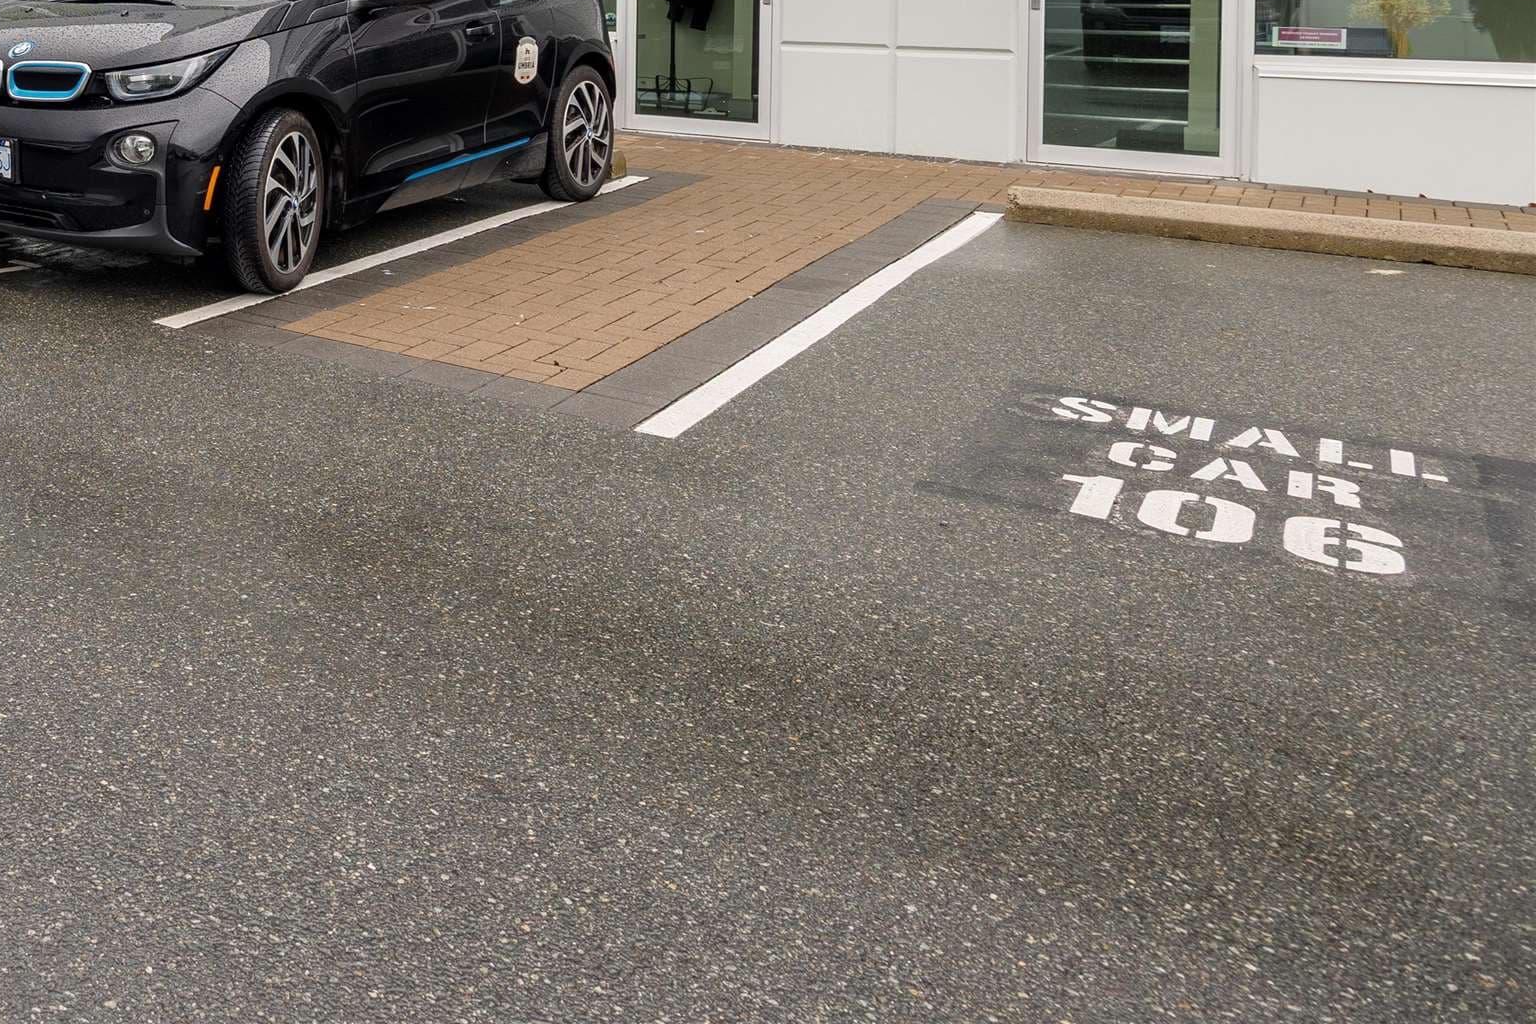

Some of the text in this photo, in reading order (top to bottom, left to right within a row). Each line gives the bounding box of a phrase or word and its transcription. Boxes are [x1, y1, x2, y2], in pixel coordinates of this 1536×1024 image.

[1051, 396, 1449, 484] SMALL
[1107, 441, 1362, 509] CAR
[1062, 474, 1406, 576] 106
